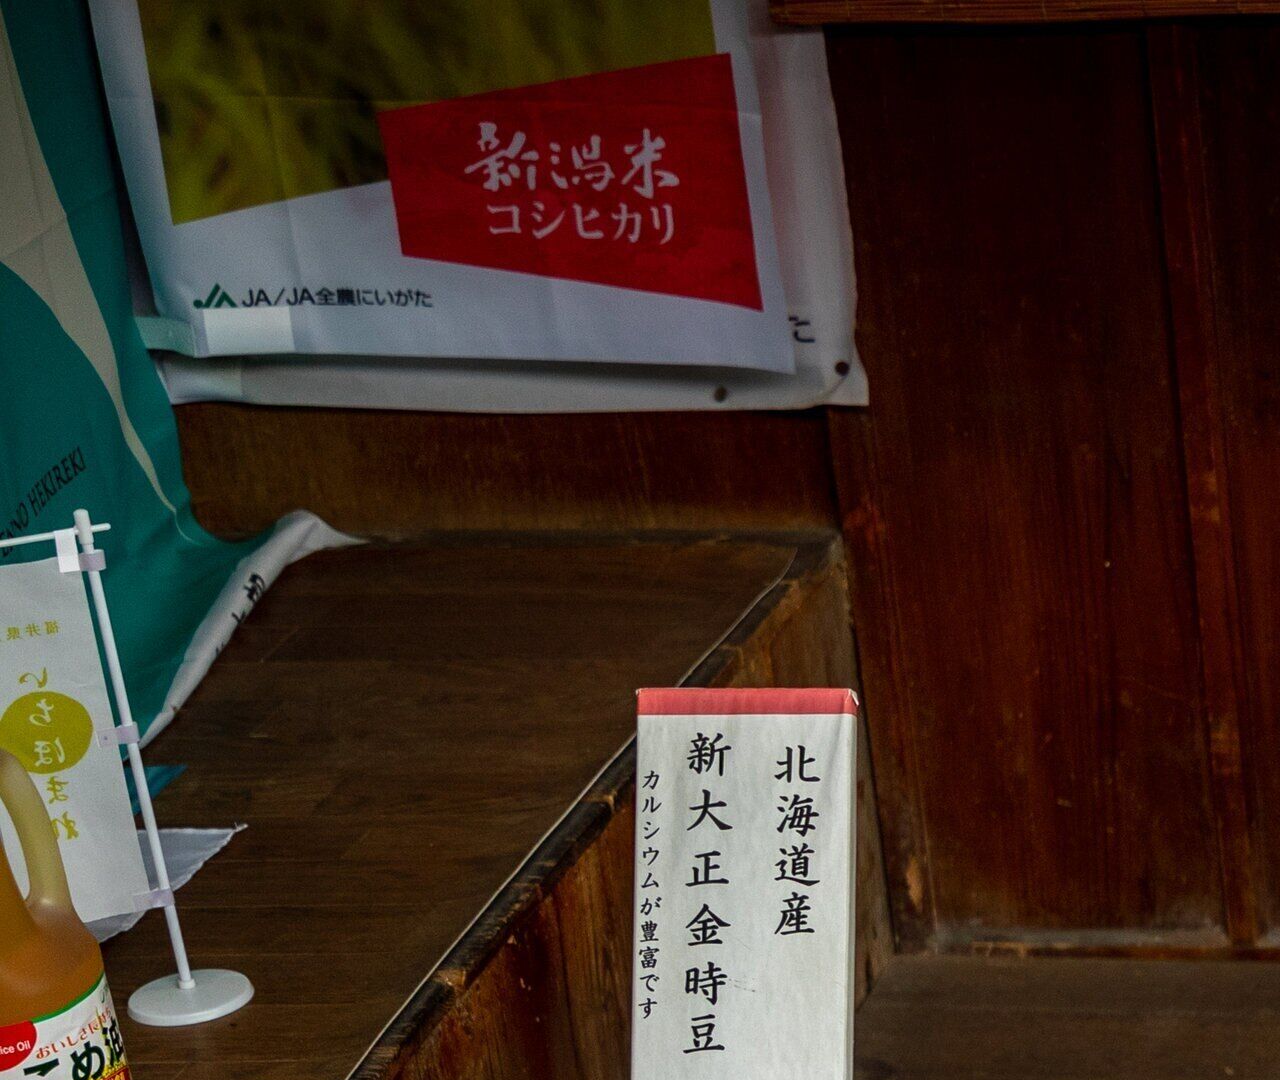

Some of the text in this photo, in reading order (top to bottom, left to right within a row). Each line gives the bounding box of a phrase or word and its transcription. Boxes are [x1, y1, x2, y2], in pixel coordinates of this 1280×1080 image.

[486, 201, 675, 246] コシヒカリ
[27, 446, 87, 518] HEKIREKI
[637, 769, 662, 1020] カルシウムが豊富です
[683, 732, 733, 1056] 新大正金時豆
[774, 743, 821, 937] 北海道産
[0, 1039, 31, 1056] ice Oil
